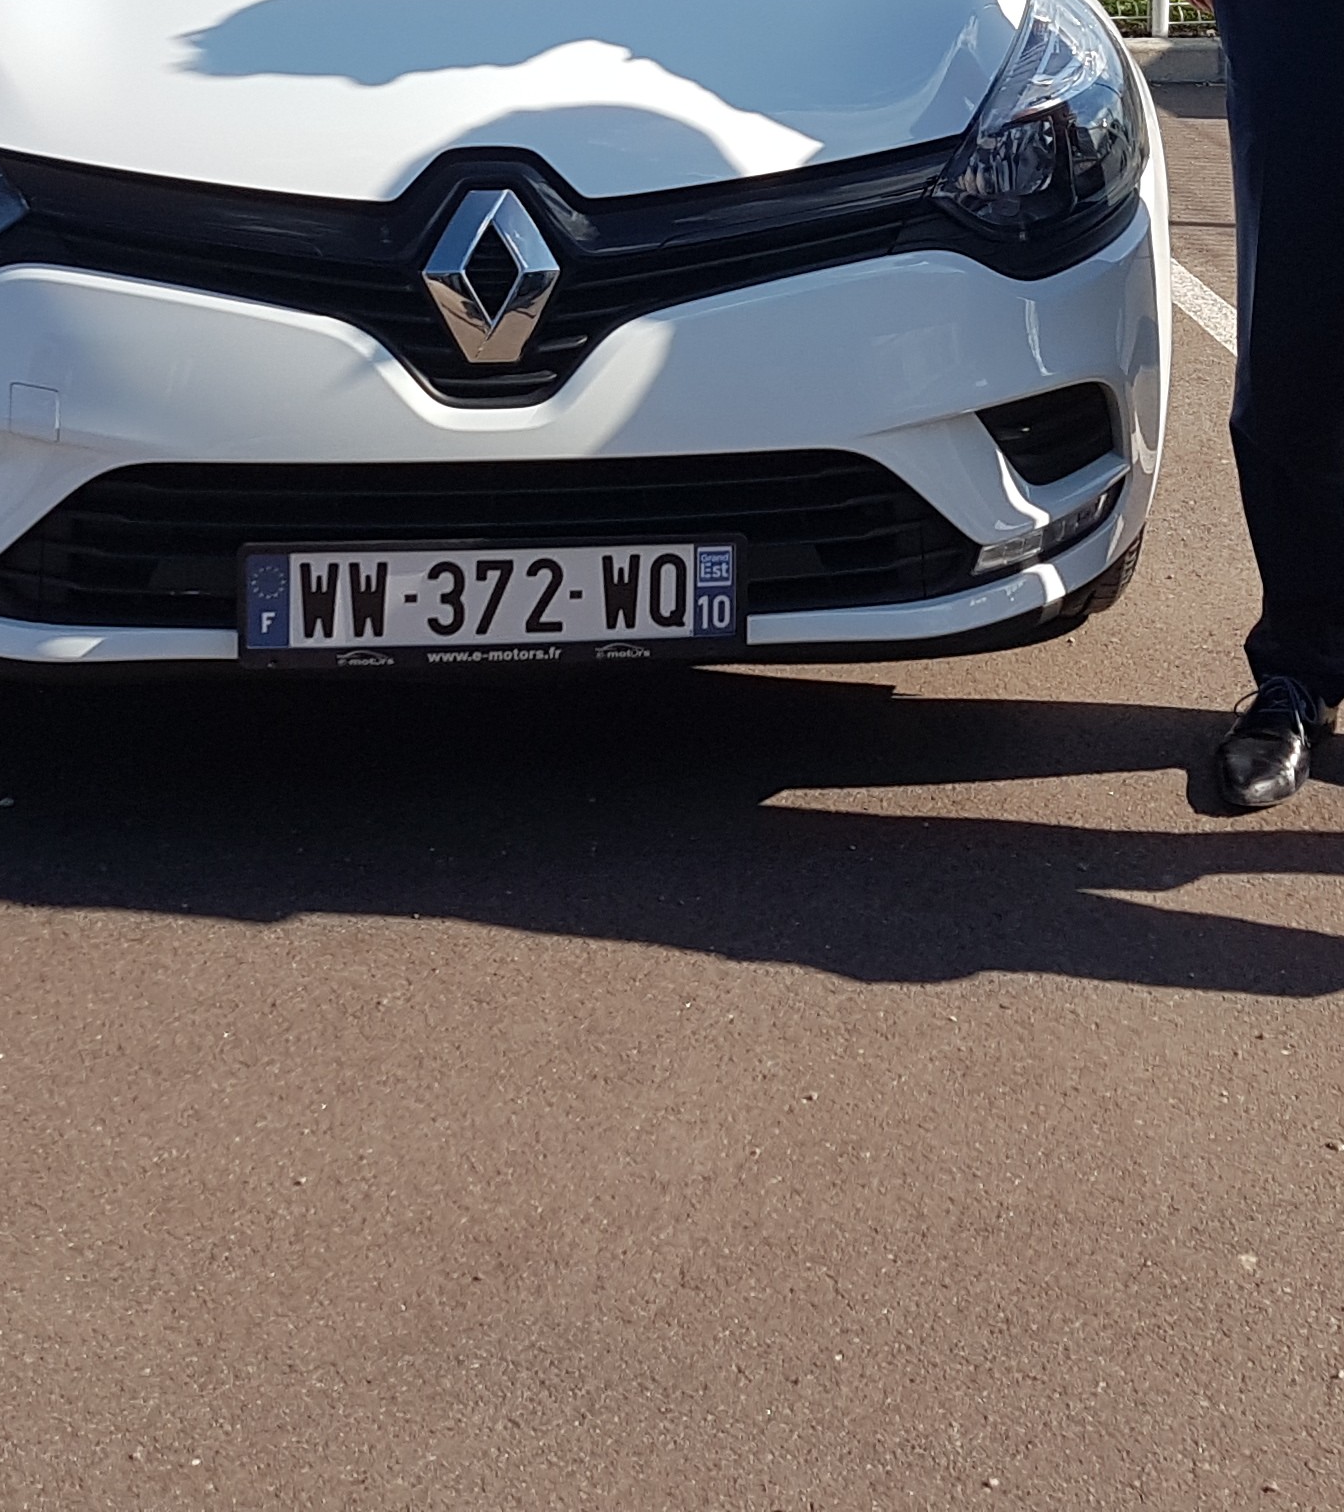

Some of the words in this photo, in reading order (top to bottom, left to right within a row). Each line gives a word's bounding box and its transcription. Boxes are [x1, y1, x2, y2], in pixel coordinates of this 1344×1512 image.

[700, 553, 730, 563] Grand
[700, 563, 729, 578] Est
[299, 553, 686, 639] WW-372-WQ
[698, 594, 731, 630] 10
[261, 612, 276, 634] F
[427, 647, 562, 663] www.e-motors.fr
